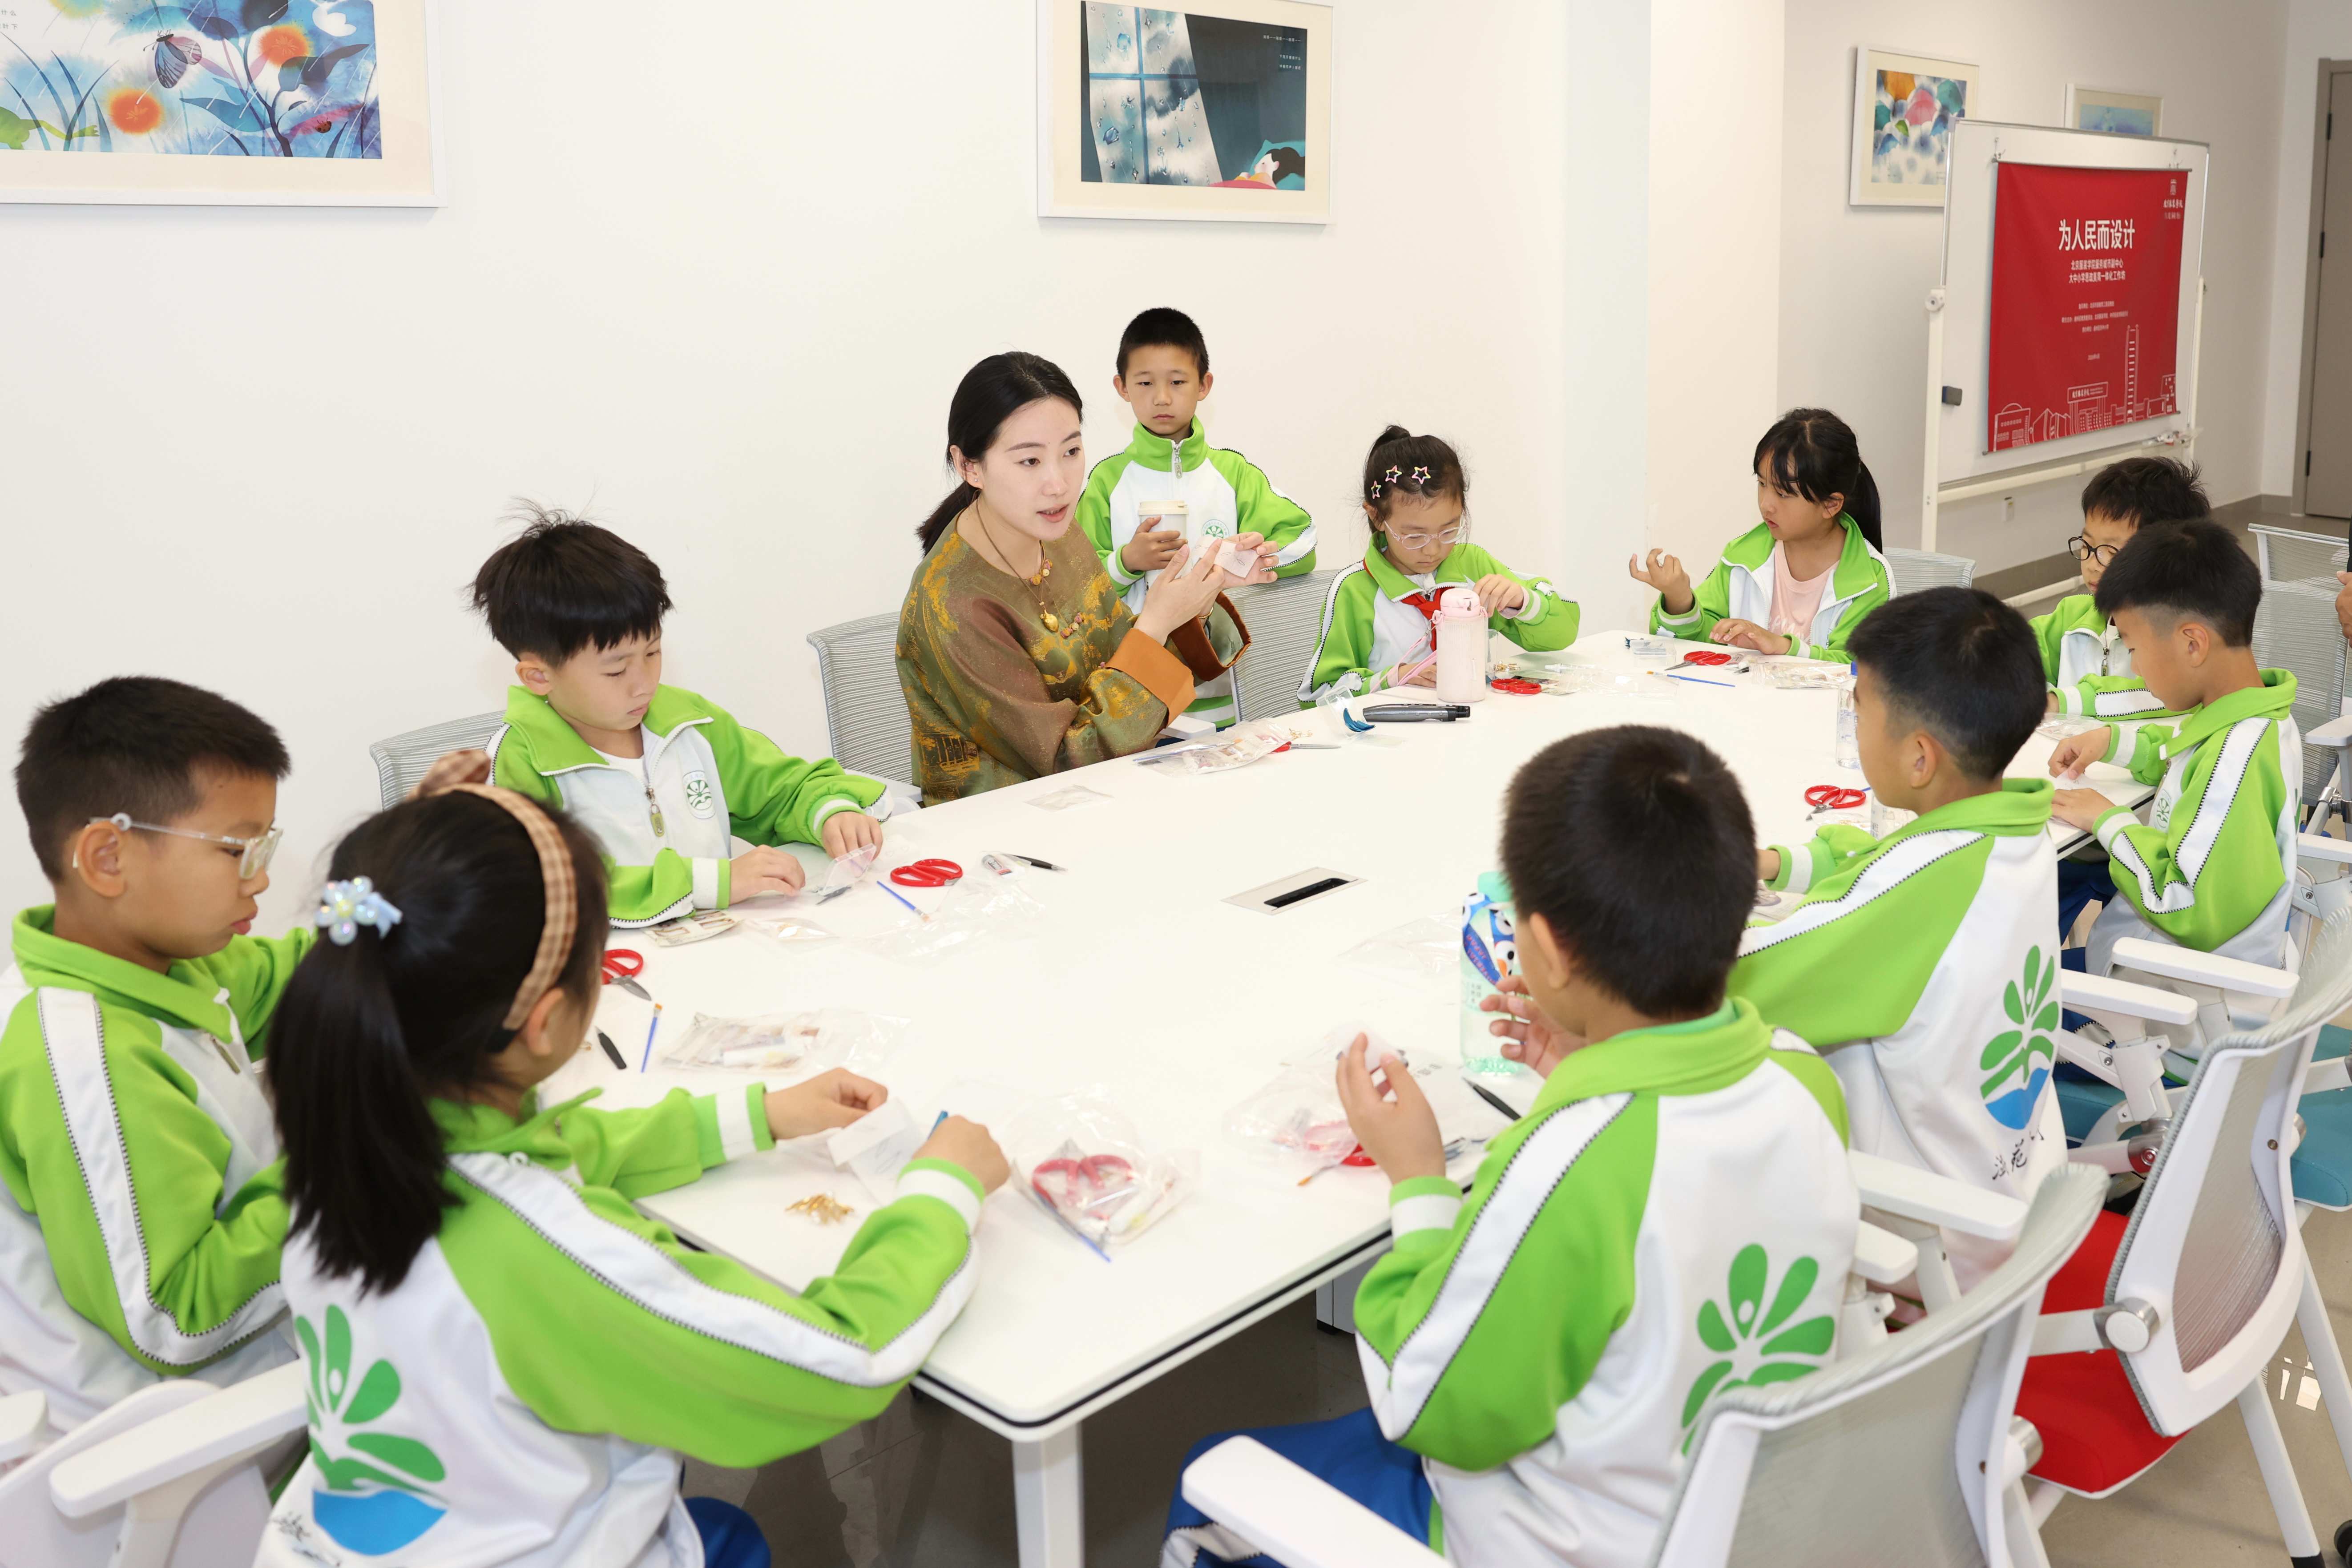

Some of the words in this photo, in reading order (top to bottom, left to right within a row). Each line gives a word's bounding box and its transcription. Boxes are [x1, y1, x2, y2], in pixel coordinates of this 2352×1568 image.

[2058, 218, 2136, 251] 为人民而设计
